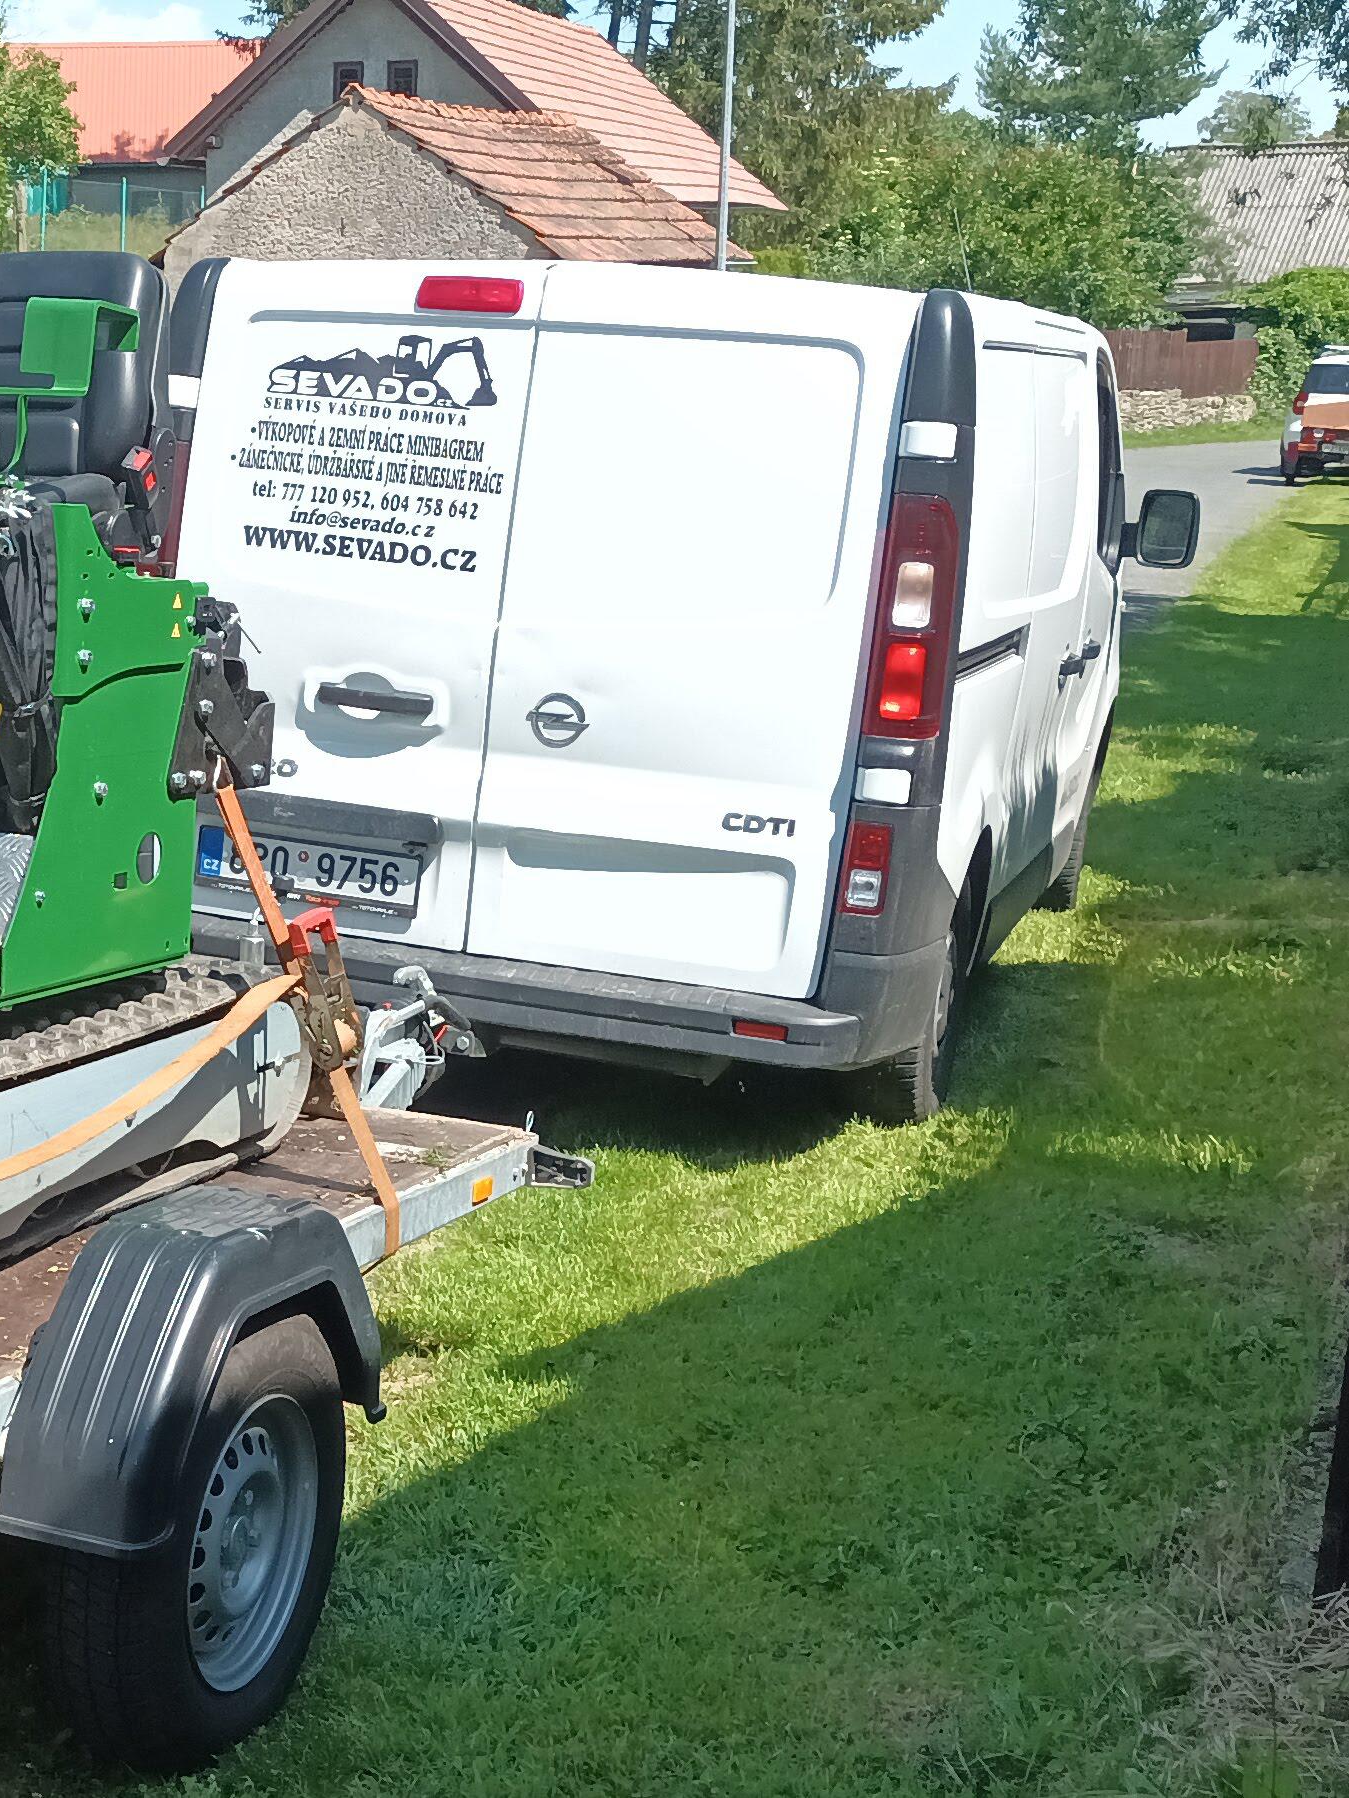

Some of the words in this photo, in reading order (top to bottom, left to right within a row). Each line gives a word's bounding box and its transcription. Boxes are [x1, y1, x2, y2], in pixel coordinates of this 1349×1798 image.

[263, 396, 321, 413] SERVIS
[328, 401, 391, 419] VAŠEHO
[398, 408, 467, 427] DOMOVA
[317, 426, 325, 447] A
[328, 424, 368, 450] ZEMNÍ
[367, 427, 405, 454] PRÁCE
[406, 434, 485, 462] MINIBAGREM
[375, 461, 383, 482] A
[383, 457, 408, 488] JINÉ
[408, 459, 467, 491] ŘEMESLNÉ
[467, 465, 504, 495] PRÁCE
[252, 479, 277, 498] tel:
[281, 482, 305, 501] 777
[310, 485, 338, 505] 120
[342, 488, 375, 511] 952,
[380, 491, 409, 513] 604
[415, 496, 444, 517] 758
[448, 500, 479, 521] 642
[288, 505, 436, 538] info@sevado.cz
[243, 525, 477, 573] WWW.SEVADO.CZ
[721, 812, 796, 837] CDTI
[203, 858, 220, 871] CZ
[315, 852, 400, 896] 9756
